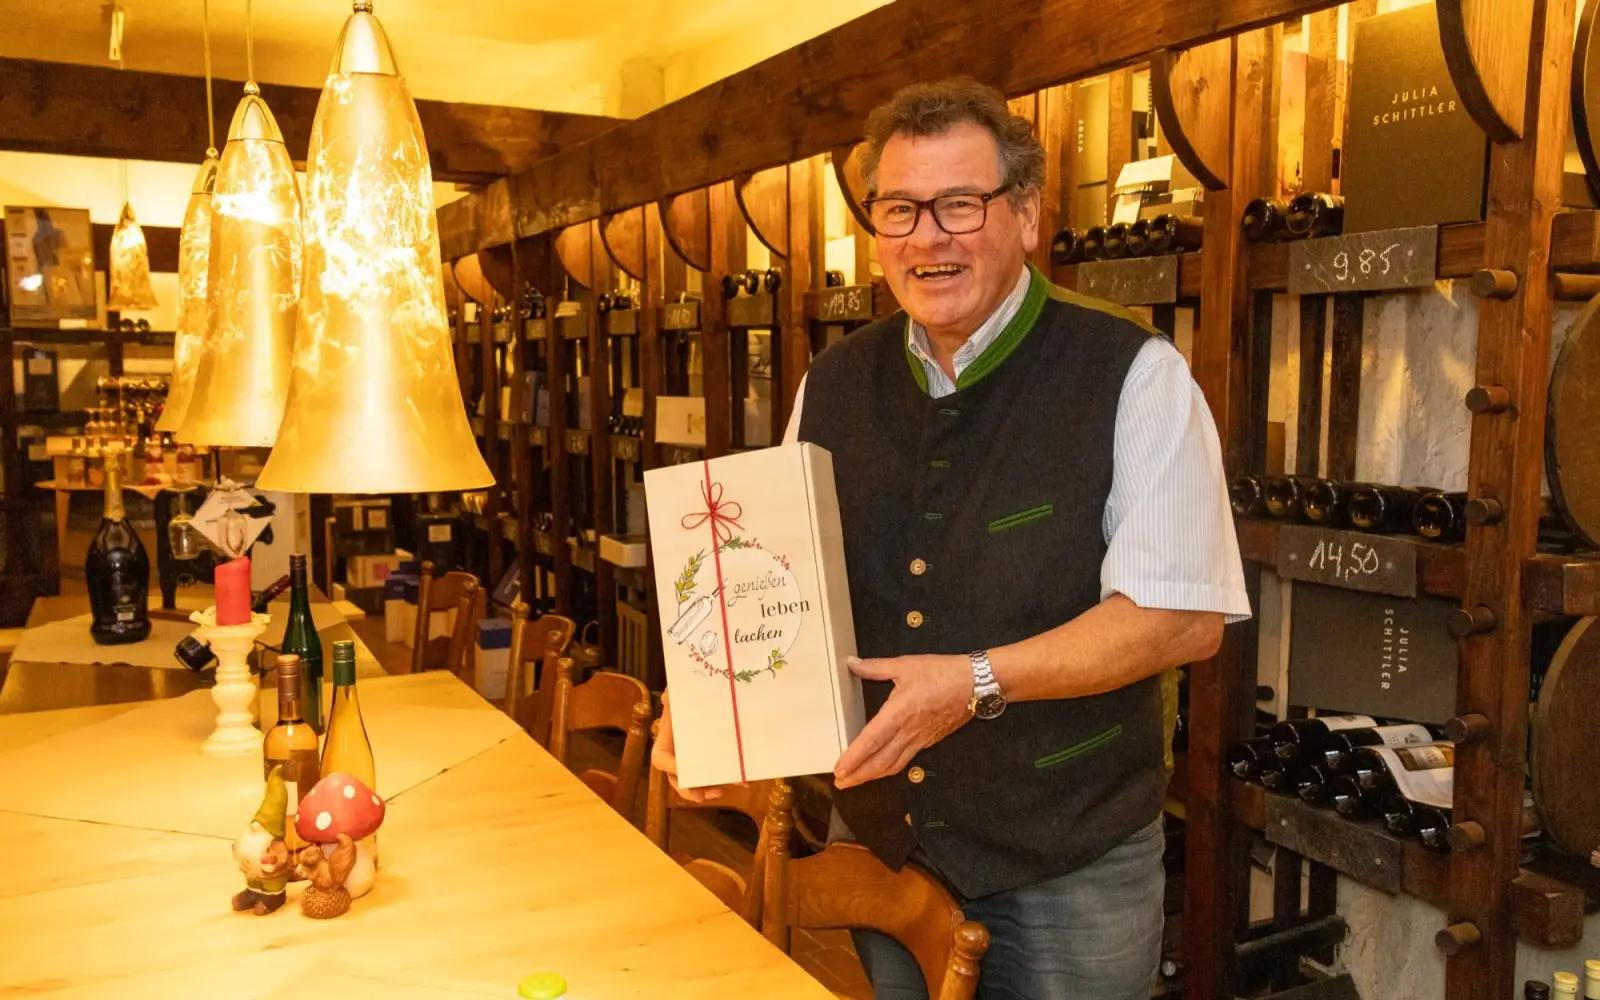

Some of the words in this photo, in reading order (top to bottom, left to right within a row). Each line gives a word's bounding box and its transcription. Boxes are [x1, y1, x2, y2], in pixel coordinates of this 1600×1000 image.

[1391, 86, 1438, 105] JULIA
[1373, 100, 1456, 126] SCHITTLER
[1333, 243, 1400, 285] 9,85
[827, 288, 862, 318] 19,85
[1308, 538, 1379, 582] 14,50
[727, 570, 786, 608] genießen
[760, 600, 810, 618] leben
[734, 623, 783, 644] lachen
[1381, 608, 1394, 690] SCHITTLER
[1397, 627, 1409, 674] JULIA
